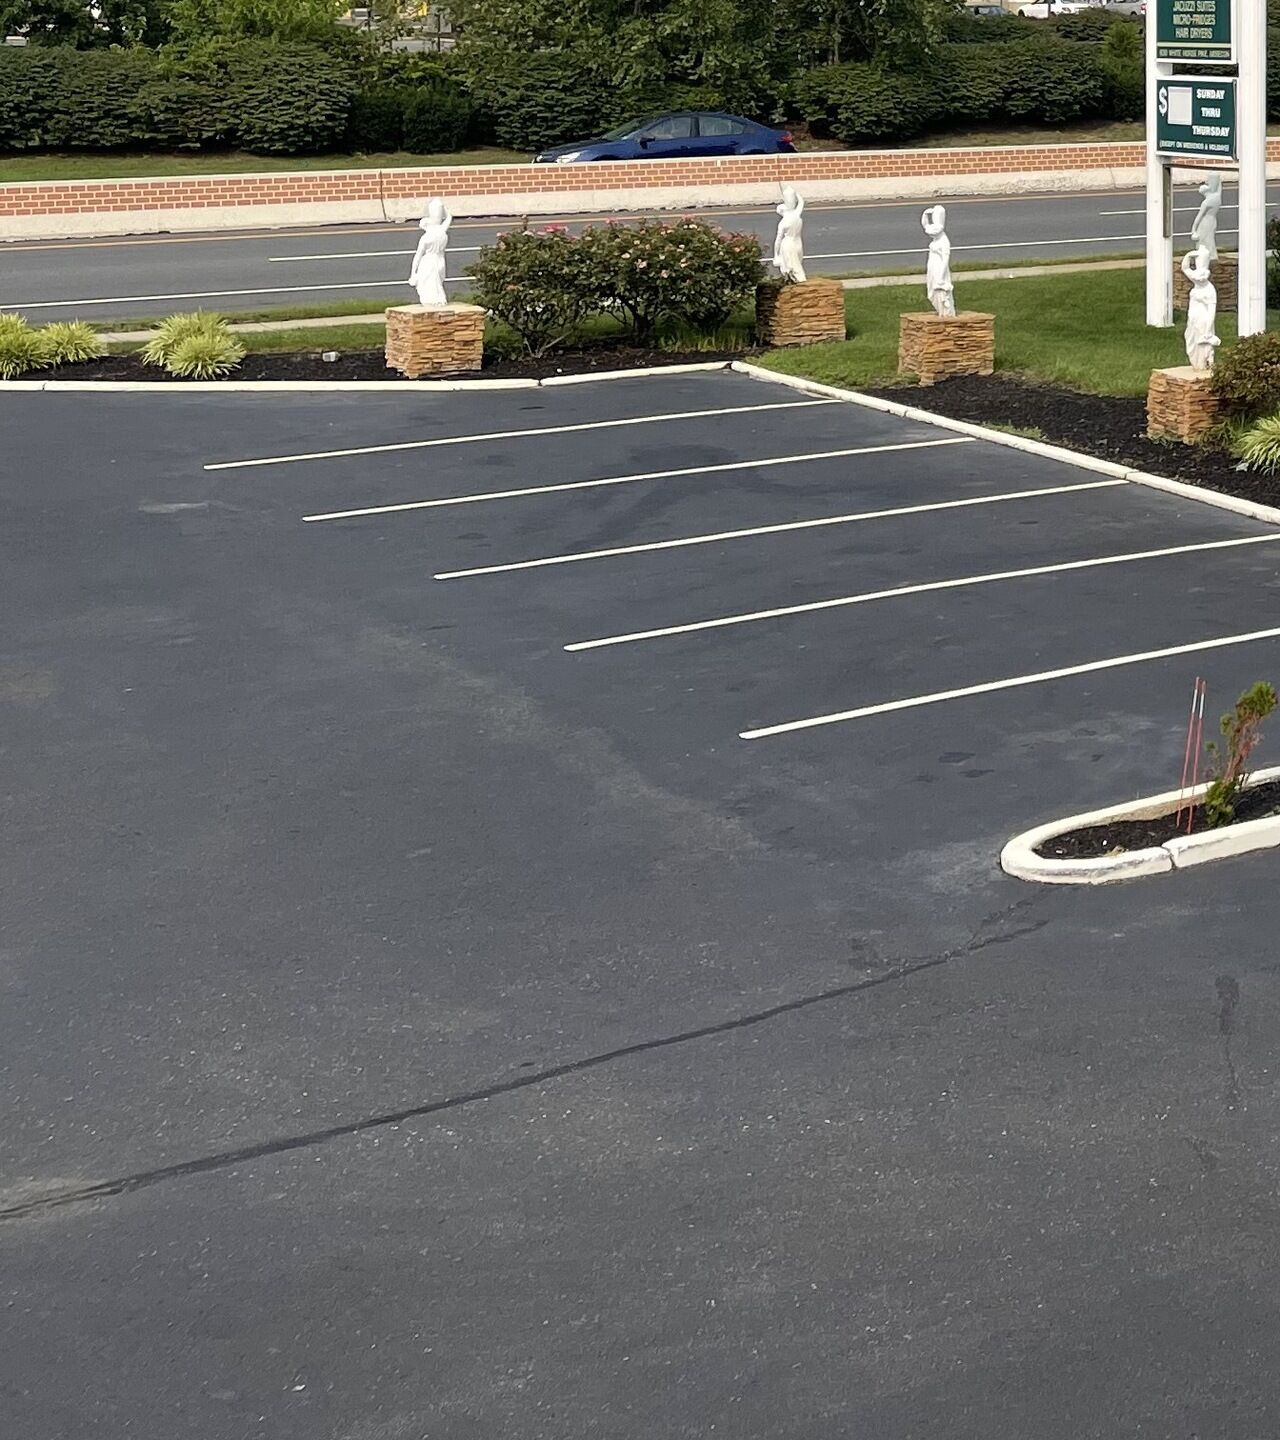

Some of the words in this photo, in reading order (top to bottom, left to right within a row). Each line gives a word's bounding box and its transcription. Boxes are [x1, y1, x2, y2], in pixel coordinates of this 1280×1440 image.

[1173, 1, 1195, 12] JACUZZI
[1197, 1, 1216, 11] SUITES
[1176, 28, 1189, 38] HAIR
[1190, 28, 1212, 39] DRYERS
[1196, 89, 1225, 100] SUNDAY
[1159, 86, 1168, 116] $
[1200, 108, 1221, 118] THRU
[1192, 126, 1230, 137] THURSDAY
